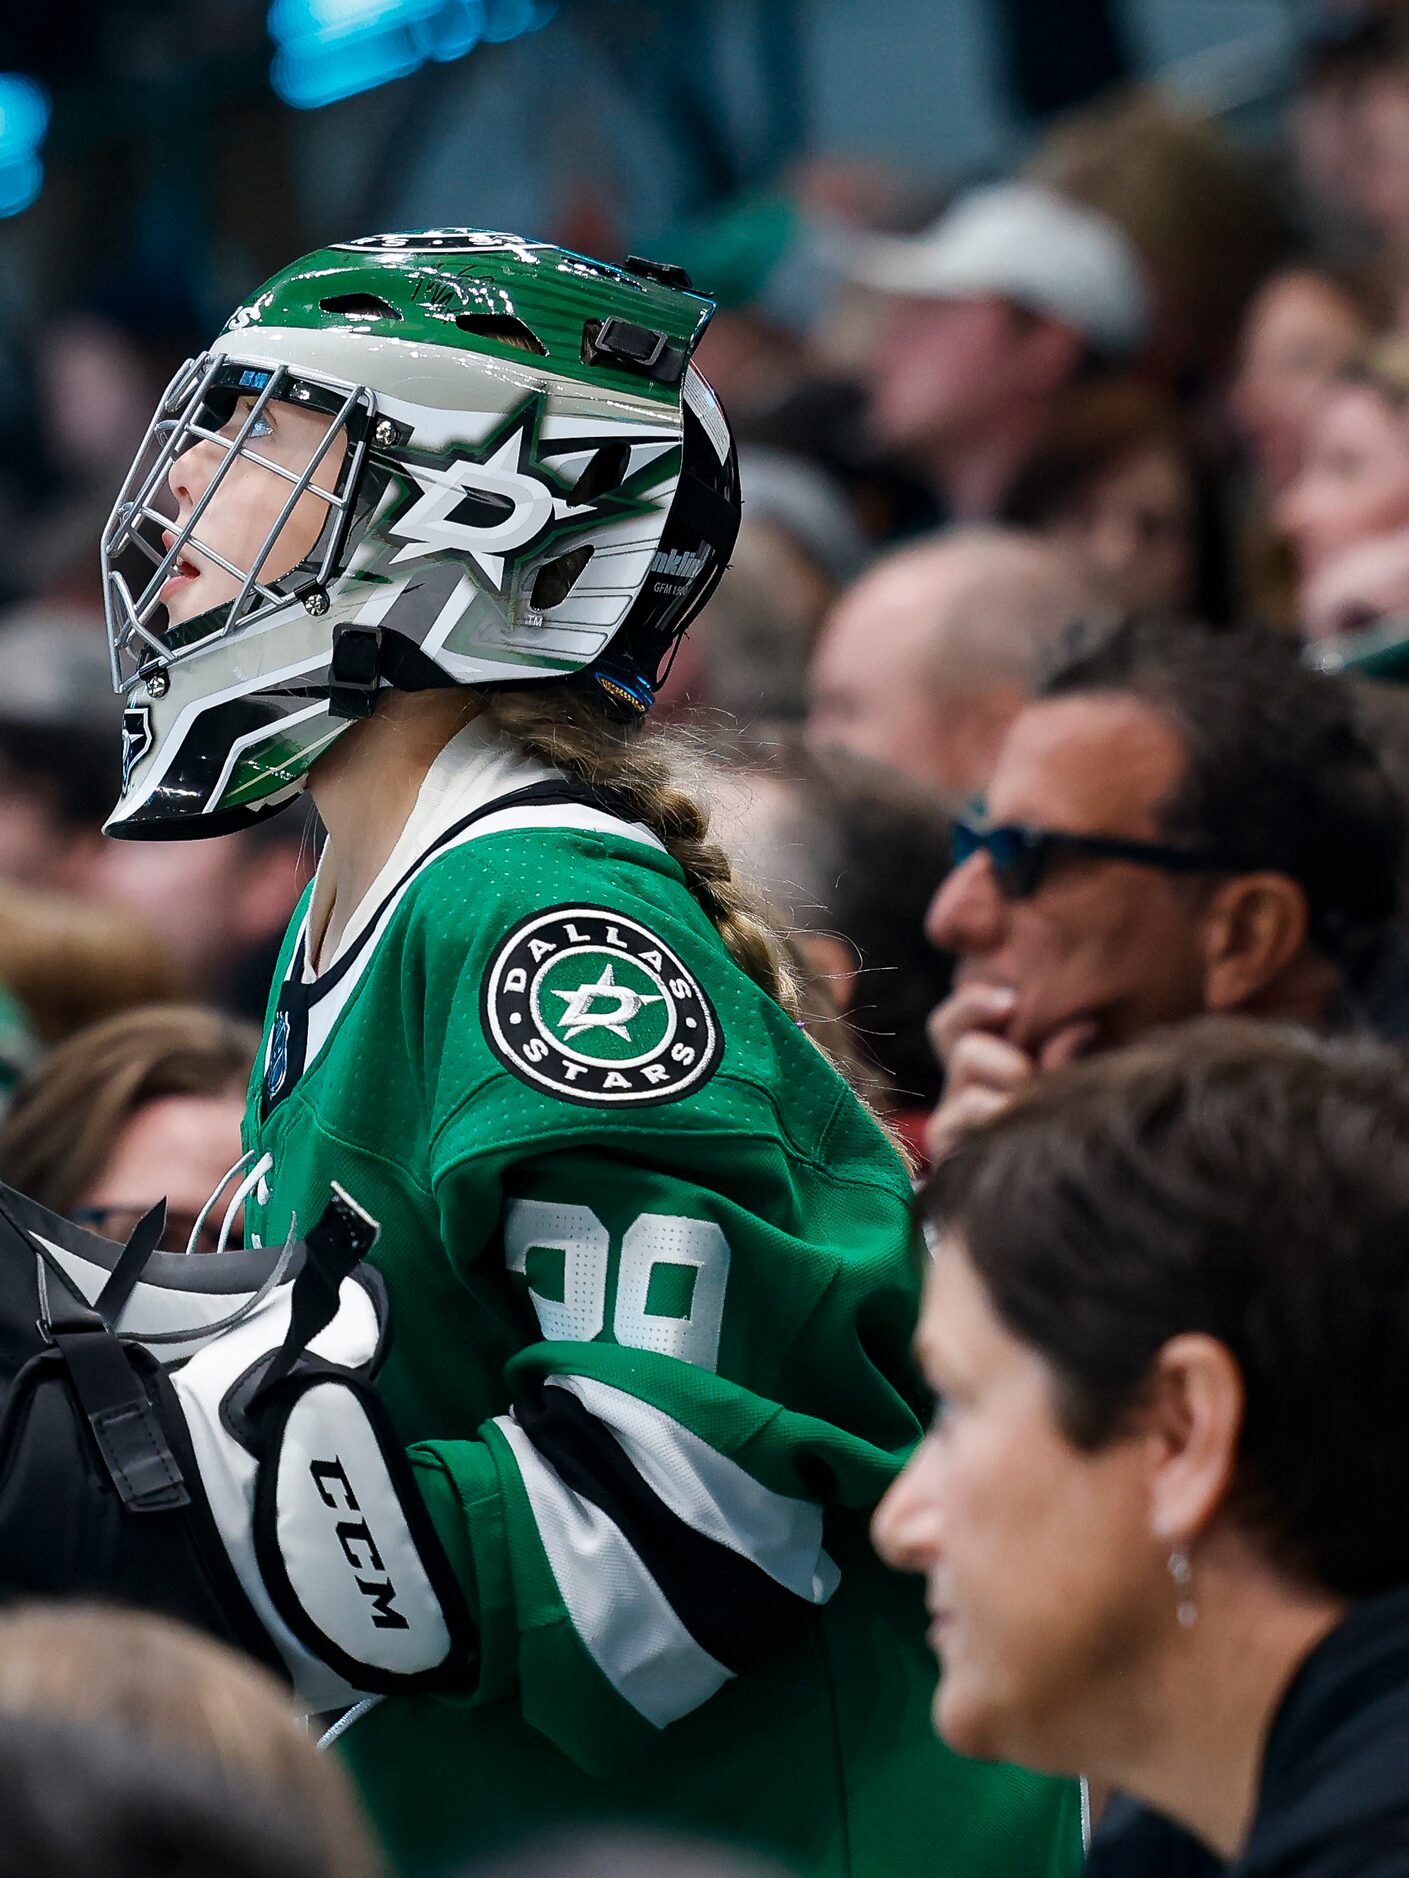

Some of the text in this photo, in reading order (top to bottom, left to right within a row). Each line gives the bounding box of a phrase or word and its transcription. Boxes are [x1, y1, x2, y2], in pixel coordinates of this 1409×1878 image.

[653, 582, 673, 594] GFM
[503, 923, 693, 1000] DALLAS
[522, 1037, 696, 1090] STARS
[309, 1454, 410, 1629] CCM
